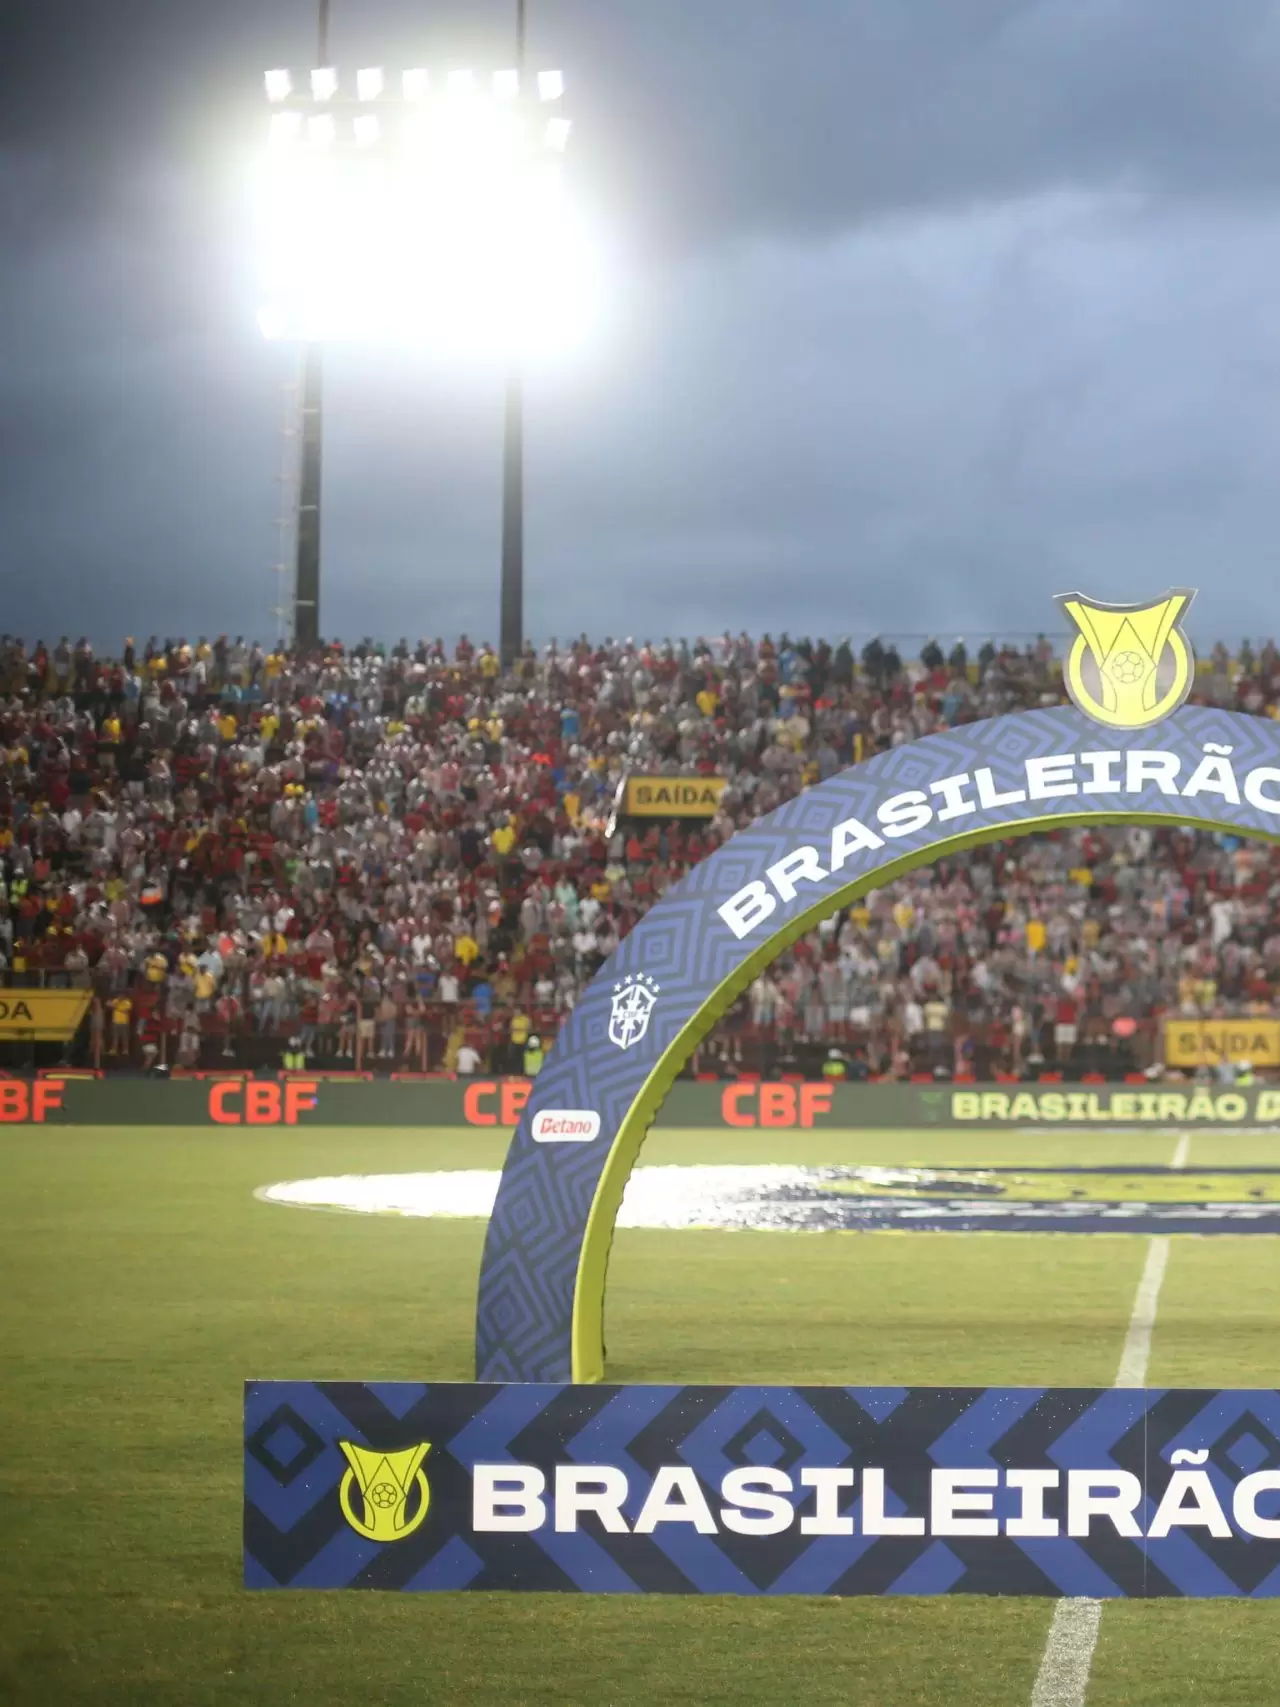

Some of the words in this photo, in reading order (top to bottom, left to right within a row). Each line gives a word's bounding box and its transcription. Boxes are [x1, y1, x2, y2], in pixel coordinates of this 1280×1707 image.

[208, 1081, 317, 1124] CBF
[721, 1081, 834, 1127] CBF
[951, 1086, 1247, 1121] BRASILEIRÃO
[540, 1117, 592, 1134] Betano
